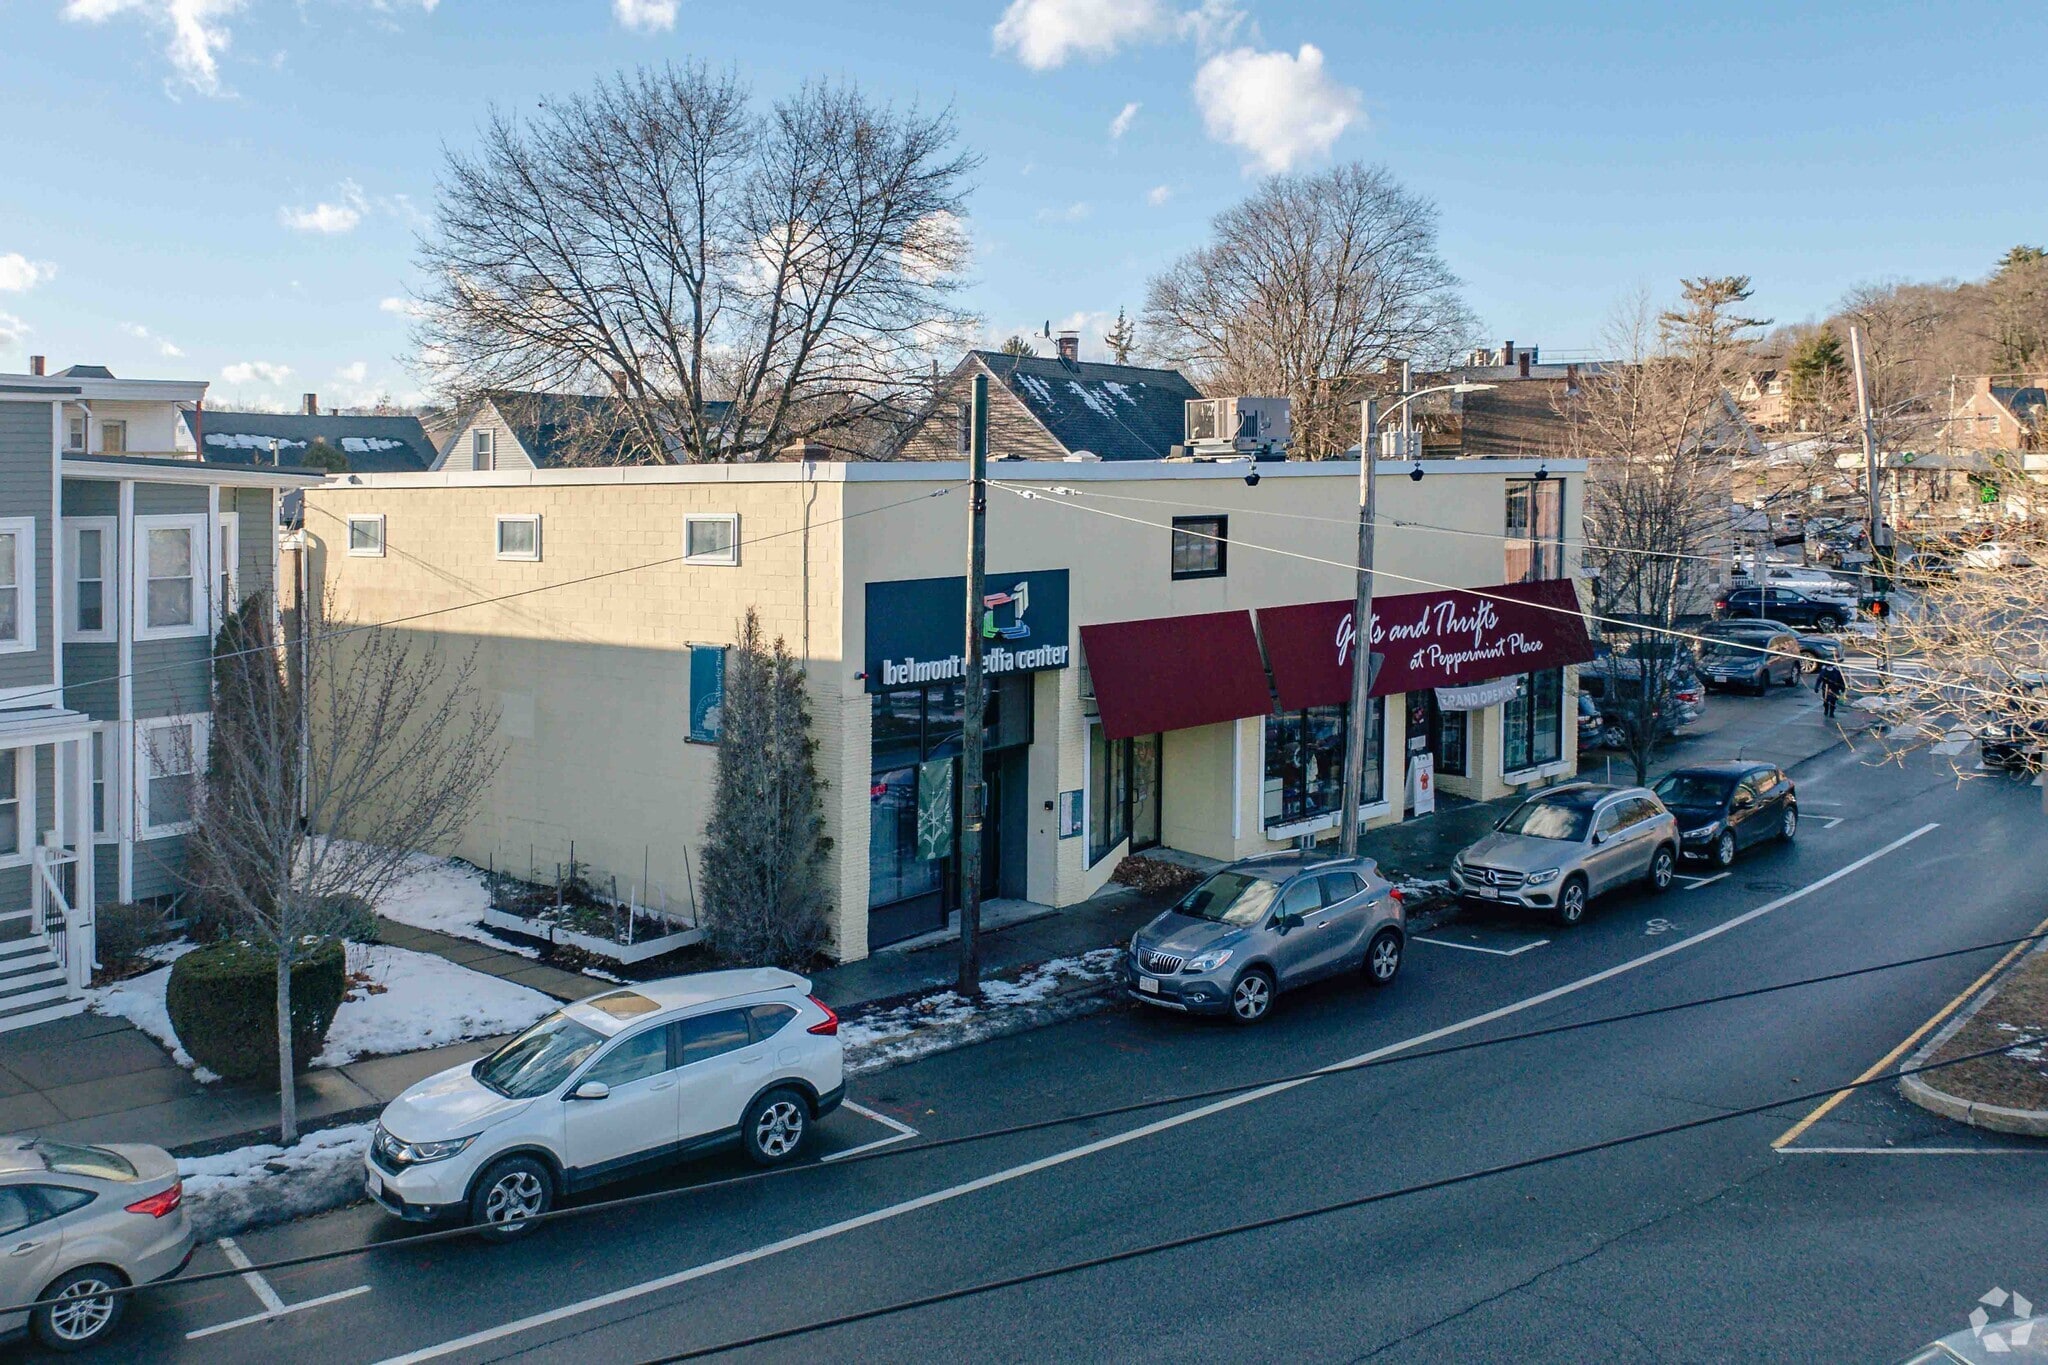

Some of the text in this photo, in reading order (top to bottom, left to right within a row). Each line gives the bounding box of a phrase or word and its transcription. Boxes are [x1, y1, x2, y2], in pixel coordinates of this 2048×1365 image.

[1336, 599, 1499, 667] Gts and Thrifts
[1409, 632, 1543, 675] at Peppermint Place
[883, 644, 1068, 686] belmont edia center
[1441, 692, 1478, 707] GRAND
